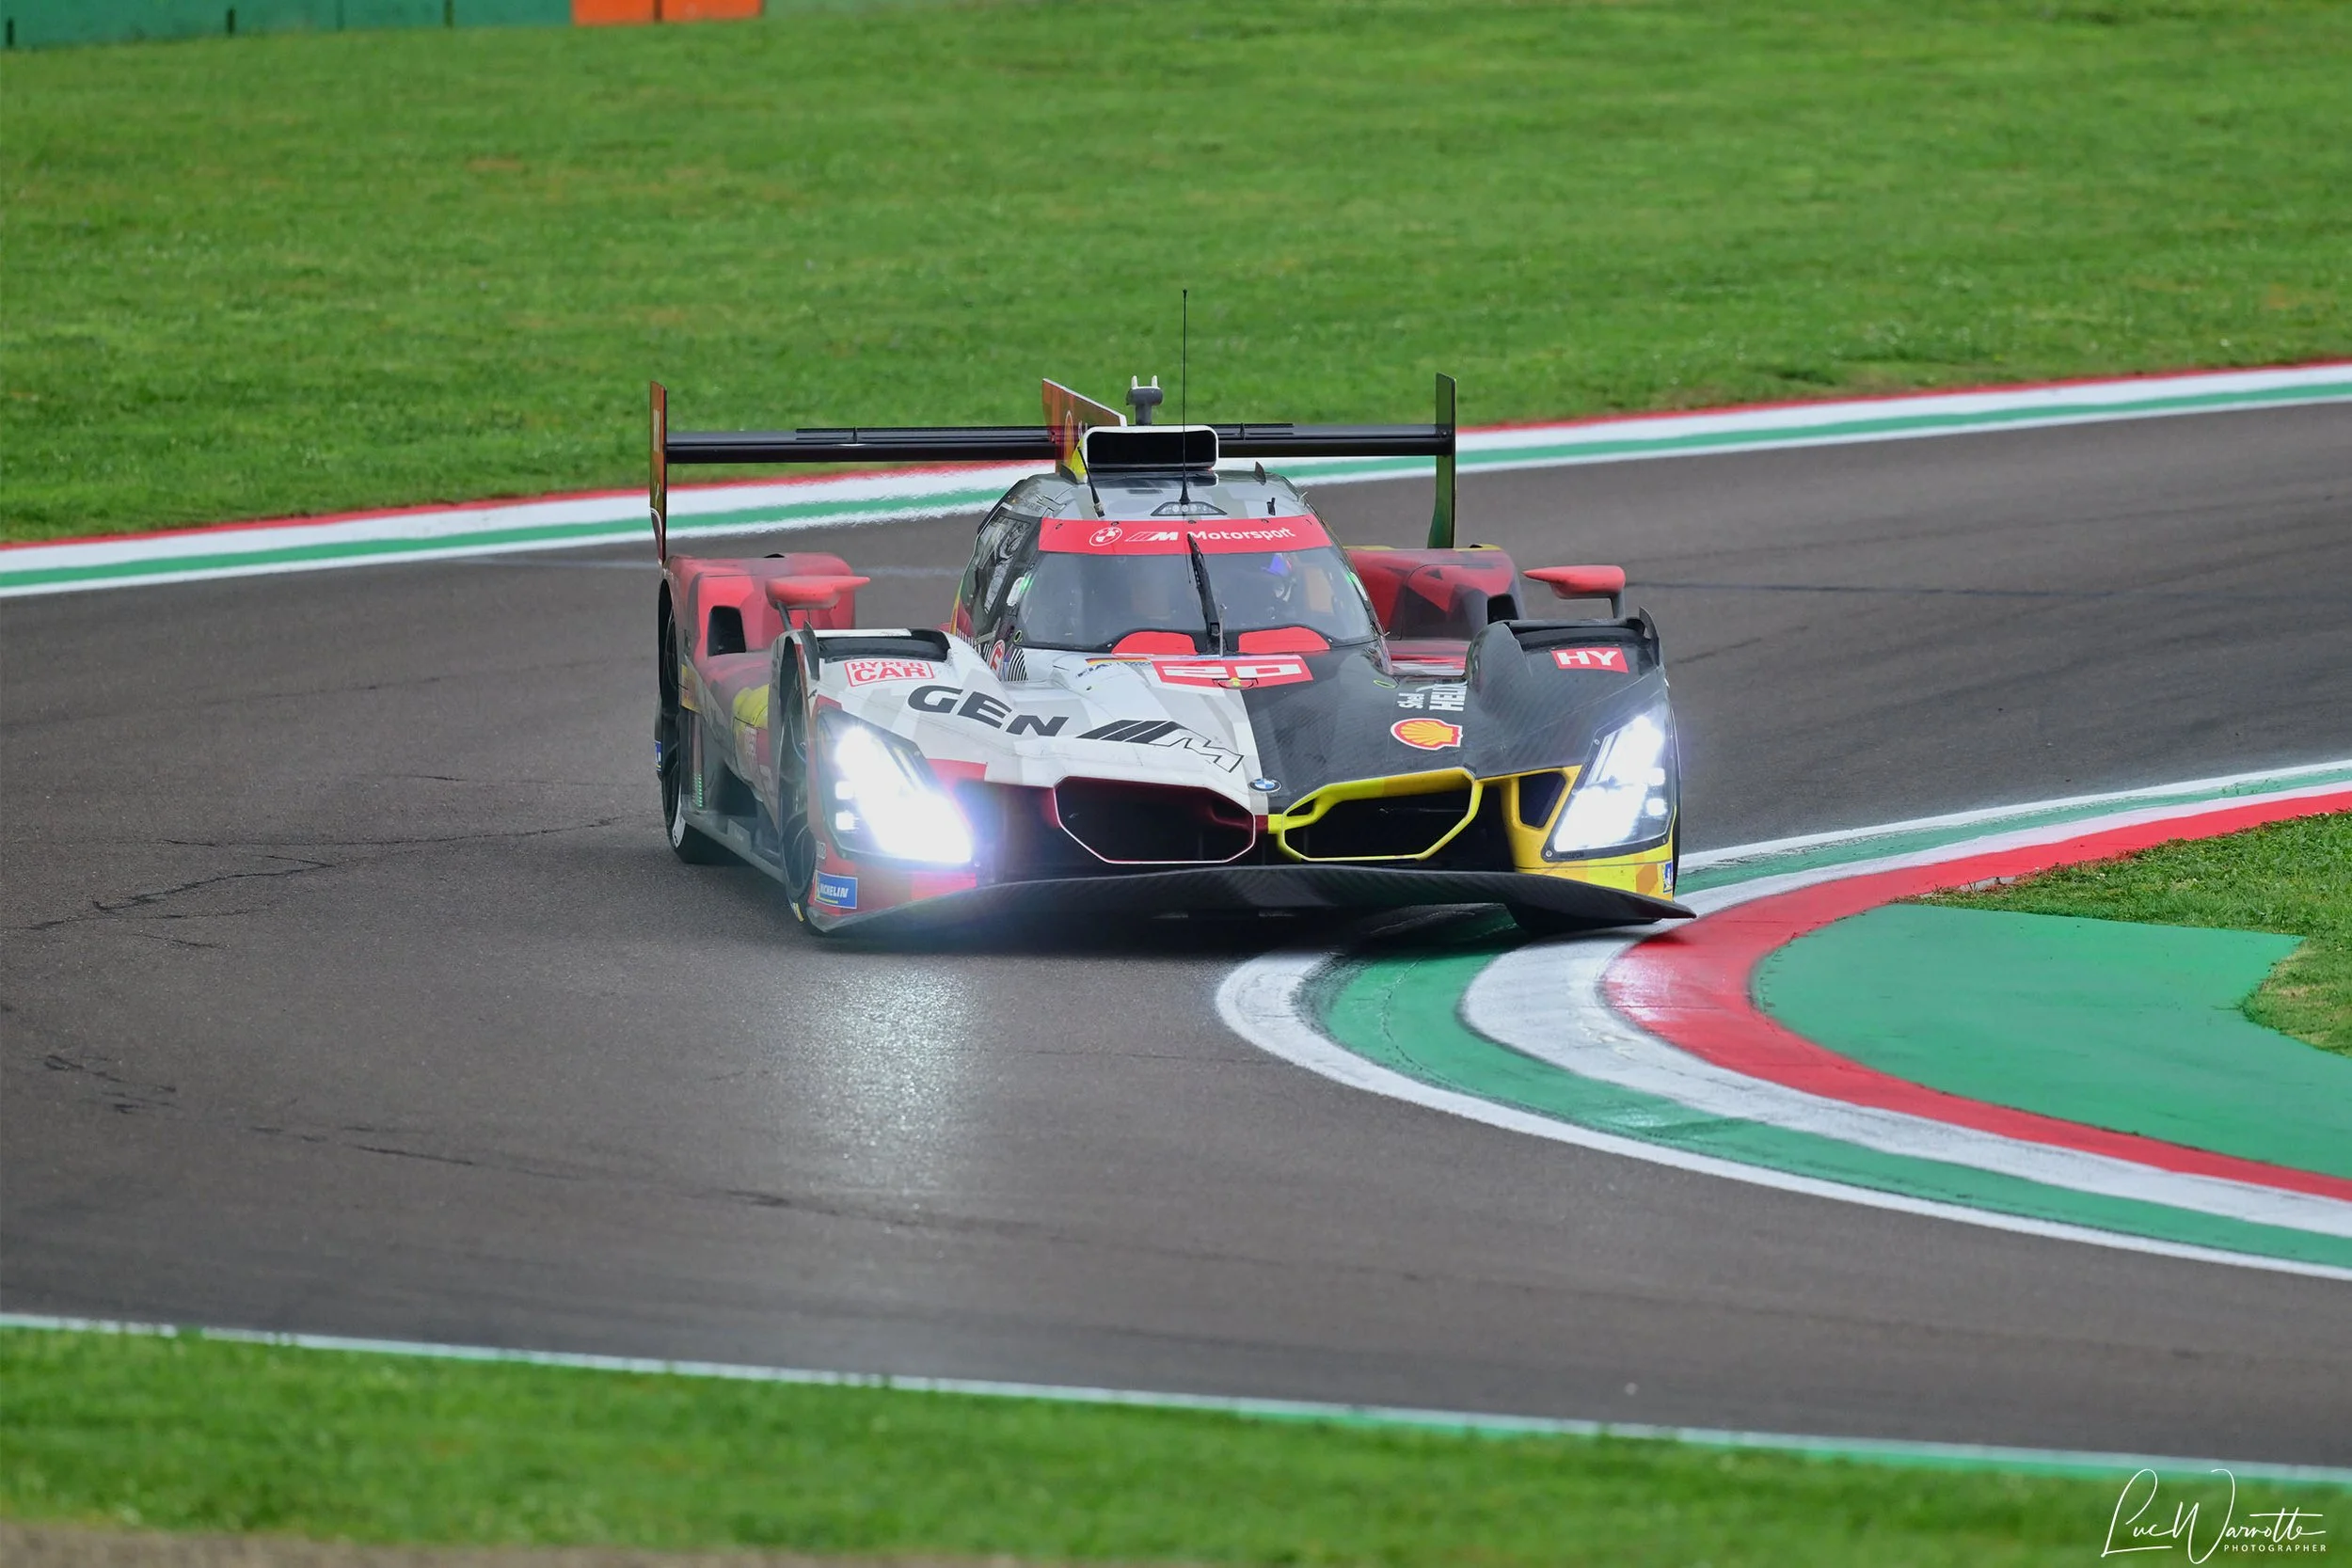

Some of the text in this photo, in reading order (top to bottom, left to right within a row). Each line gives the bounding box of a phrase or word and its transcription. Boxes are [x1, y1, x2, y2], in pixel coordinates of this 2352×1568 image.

[1188, 528, 1296, 540] Motorsport
[851, 661, 923, 670] HYPER
[1556, 650, 1617, 666] HY
[854, 667, 927, 682] CAR
[1162, 664, 1302, 678] 20
[1397, 692, 1424, 709] Shell
[906, 685, 1070, 737] GEN
